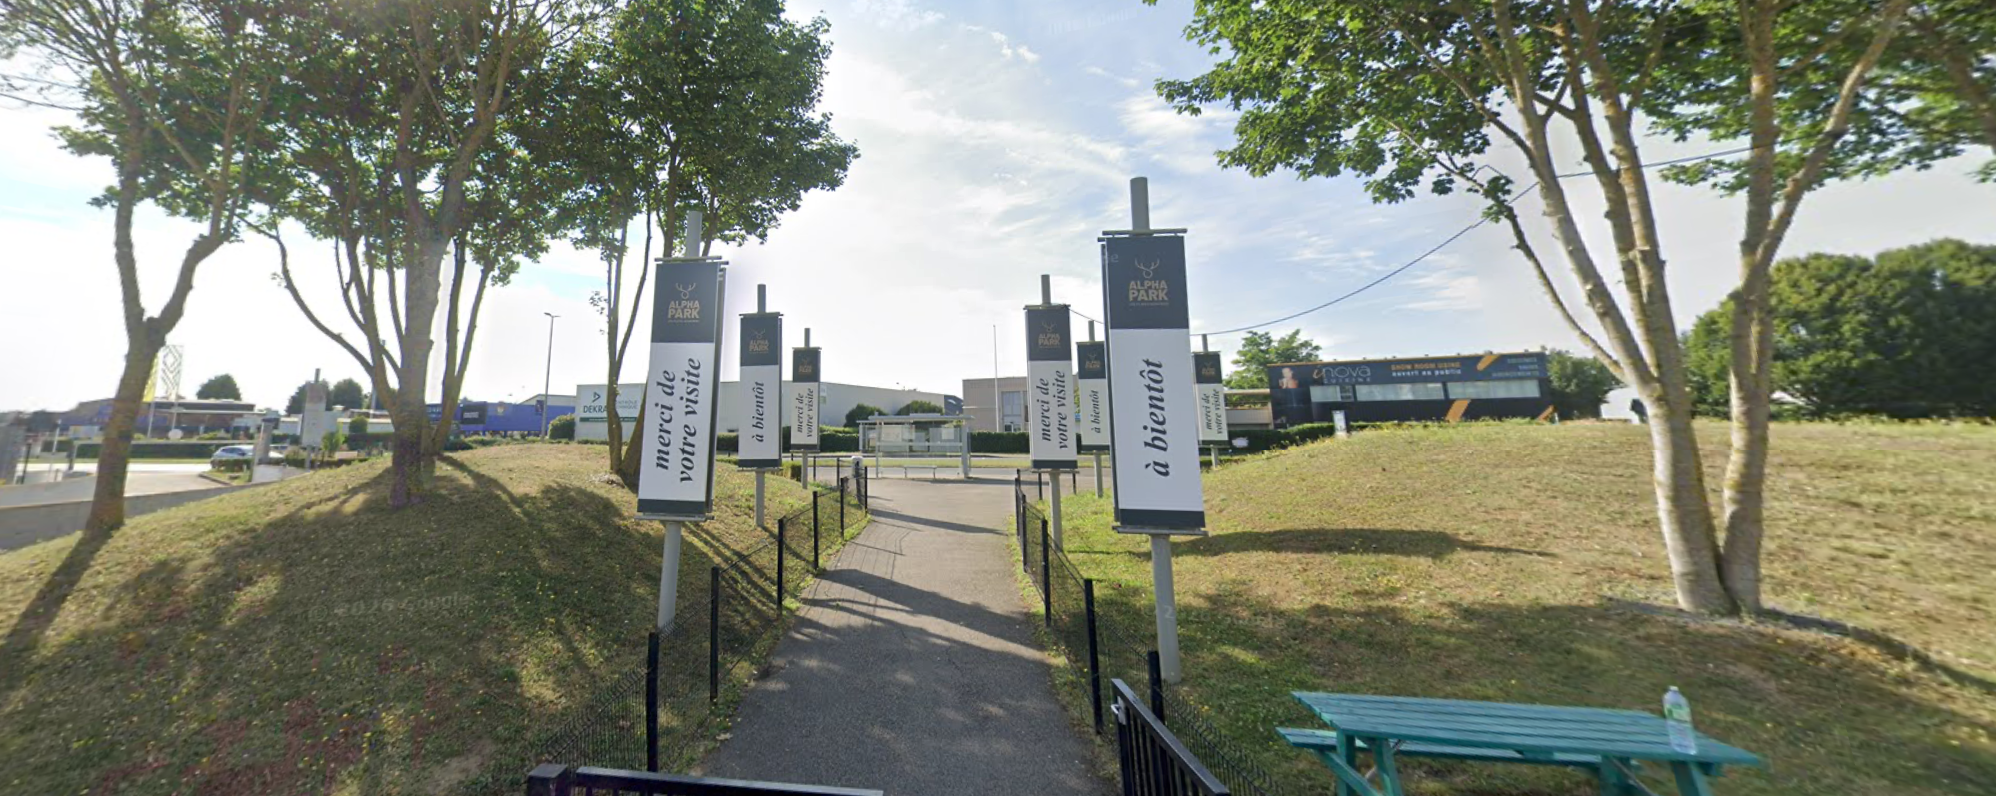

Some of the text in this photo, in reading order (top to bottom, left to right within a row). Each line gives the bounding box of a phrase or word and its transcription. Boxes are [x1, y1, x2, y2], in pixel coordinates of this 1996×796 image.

[669, 300, 700, 308] ALPHA
[1129, 280, 1168, 289] ALPHA
[1129, 288, 1169, 301] PARK
[668, 308, 700, 319] PARK
[1038, 338, 1061, 346] PARK
[751, 381, 766, 443] à bientôt
[795, 392, 804, 433] merci de
[804, 388, 814, 438] votre visite
[1035, 378, 1052, 442] merci de
[1052, 370, 1069, 450] votre visite
[1088, 390, 1101, 425] bientôt
[1139, 358, 1171, 478] à bientôt
[1201, 393, 1213, 430] merci de
[1211, 388, 1221, 411] visite
[655, 369, 676, 471] merci de
[679, 357, 701, 483] votre visite
